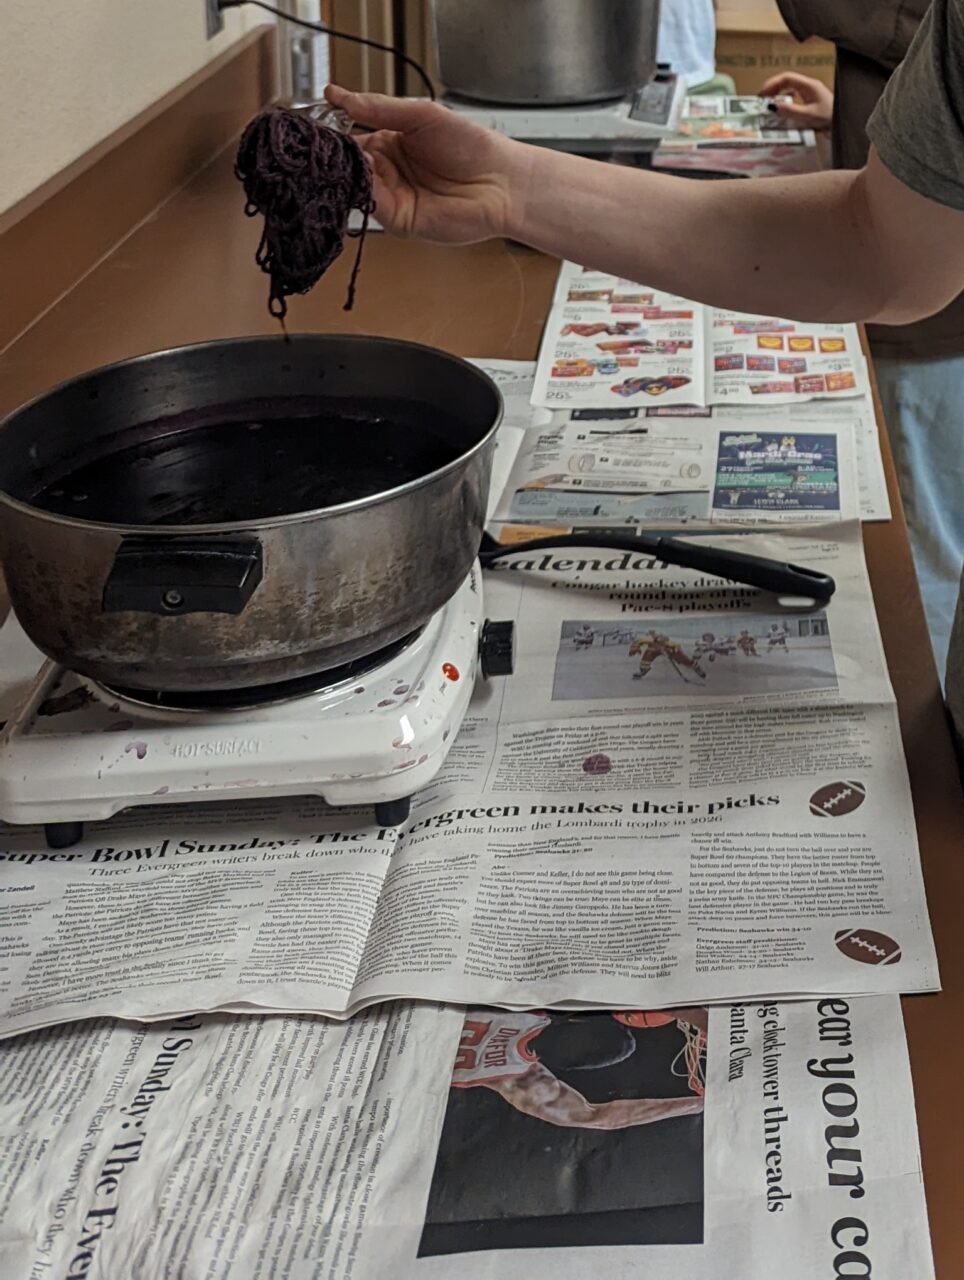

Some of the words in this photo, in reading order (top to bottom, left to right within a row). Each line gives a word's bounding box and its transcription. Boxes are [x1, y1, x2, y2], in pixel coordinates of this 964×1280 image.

[551, 579, 621, 591] Cougar
[625, 577, 690, 591] hockey
[609, 590, 666, 601] round
[670, 591, 705, 601] one
[709, 589, 728, 599] of
[731, 587, 762, 598] the
[620, 602, 674, 614] Pac-8
[679, 598, 752, 614] playoffs
[88, 866, 132, 877] Three
[136, 859, 207, 873] Evergreen
[210, 853, 258, 866] writers
[262, 850, 301, 862] break
[305, 847, 344, 859] down
[348, 846, 378, 855] who
[408, 830, 439, 846] have
[443, 824, 485, 838] taking
[488, 824, 527, 834] home
[531, 821, 552, 831] the
[555, 818, 624, 829] Lombardi
[625, 817, 671, 830] trophy
[673, 816, 687, 826] in
[690, 814, 723, 826] 2026
[90, 839, 171, 863] Bowl
[174, 837, 301, 857] Sunday:
[310, 831, 368, 845] The
[530, 801, 624, 815] makes
[631, 800, 701, 815] their
[707, 793, 781, 815] picks
[638, 869, 656, 878] being
[815, 998, 853, 1047] ear
[119, 1036, 194, 1129] Sunday:
[727, 1046, 752, 1083] Clara
[106, 1067, 131, 1105] writers
[85, 1104, 114, 1138] break
[806, 1052, 865, 1199] your
[69, 1139, 98, 1185] down
[94, 1131, 147, 1196] The
[763, 1106, 792, 1213] threads
[53, 1185, 78, 1218] who
